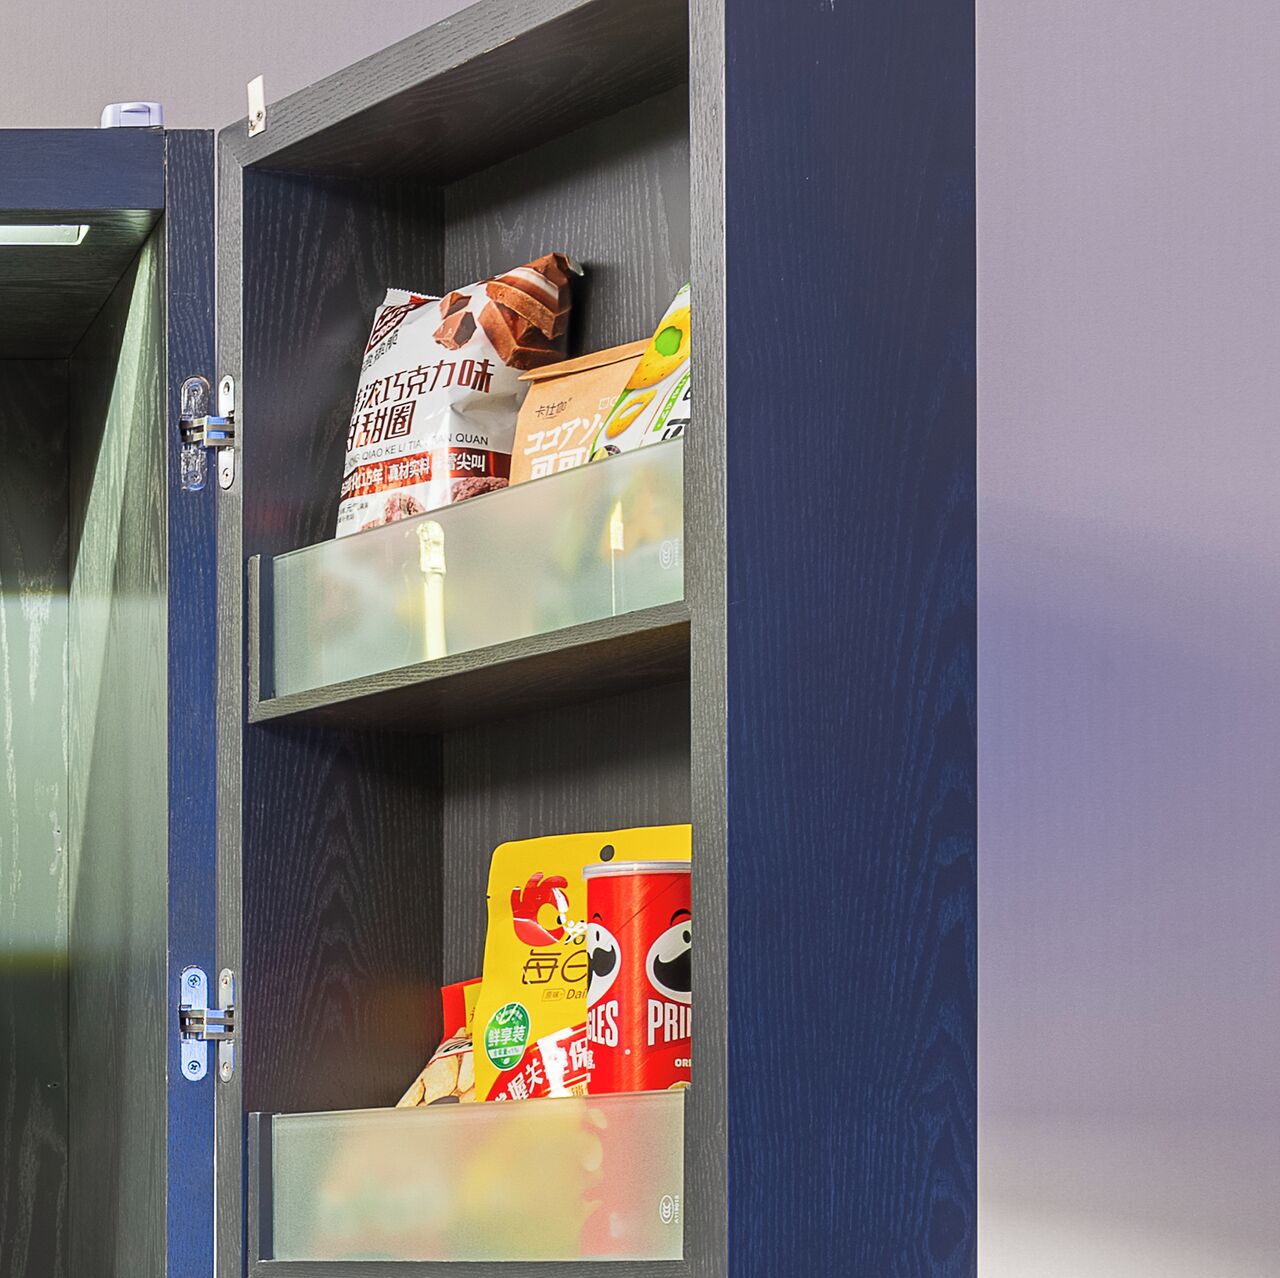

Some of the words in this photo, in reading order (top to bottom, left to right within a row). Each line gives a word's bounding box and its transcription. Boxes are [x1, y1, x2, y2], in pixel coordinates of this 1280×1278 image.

[456, 433, 488, 446] QUAN
[524, 414, 602, 456] ココアソ
[531, 446, 590, 480] 可可
